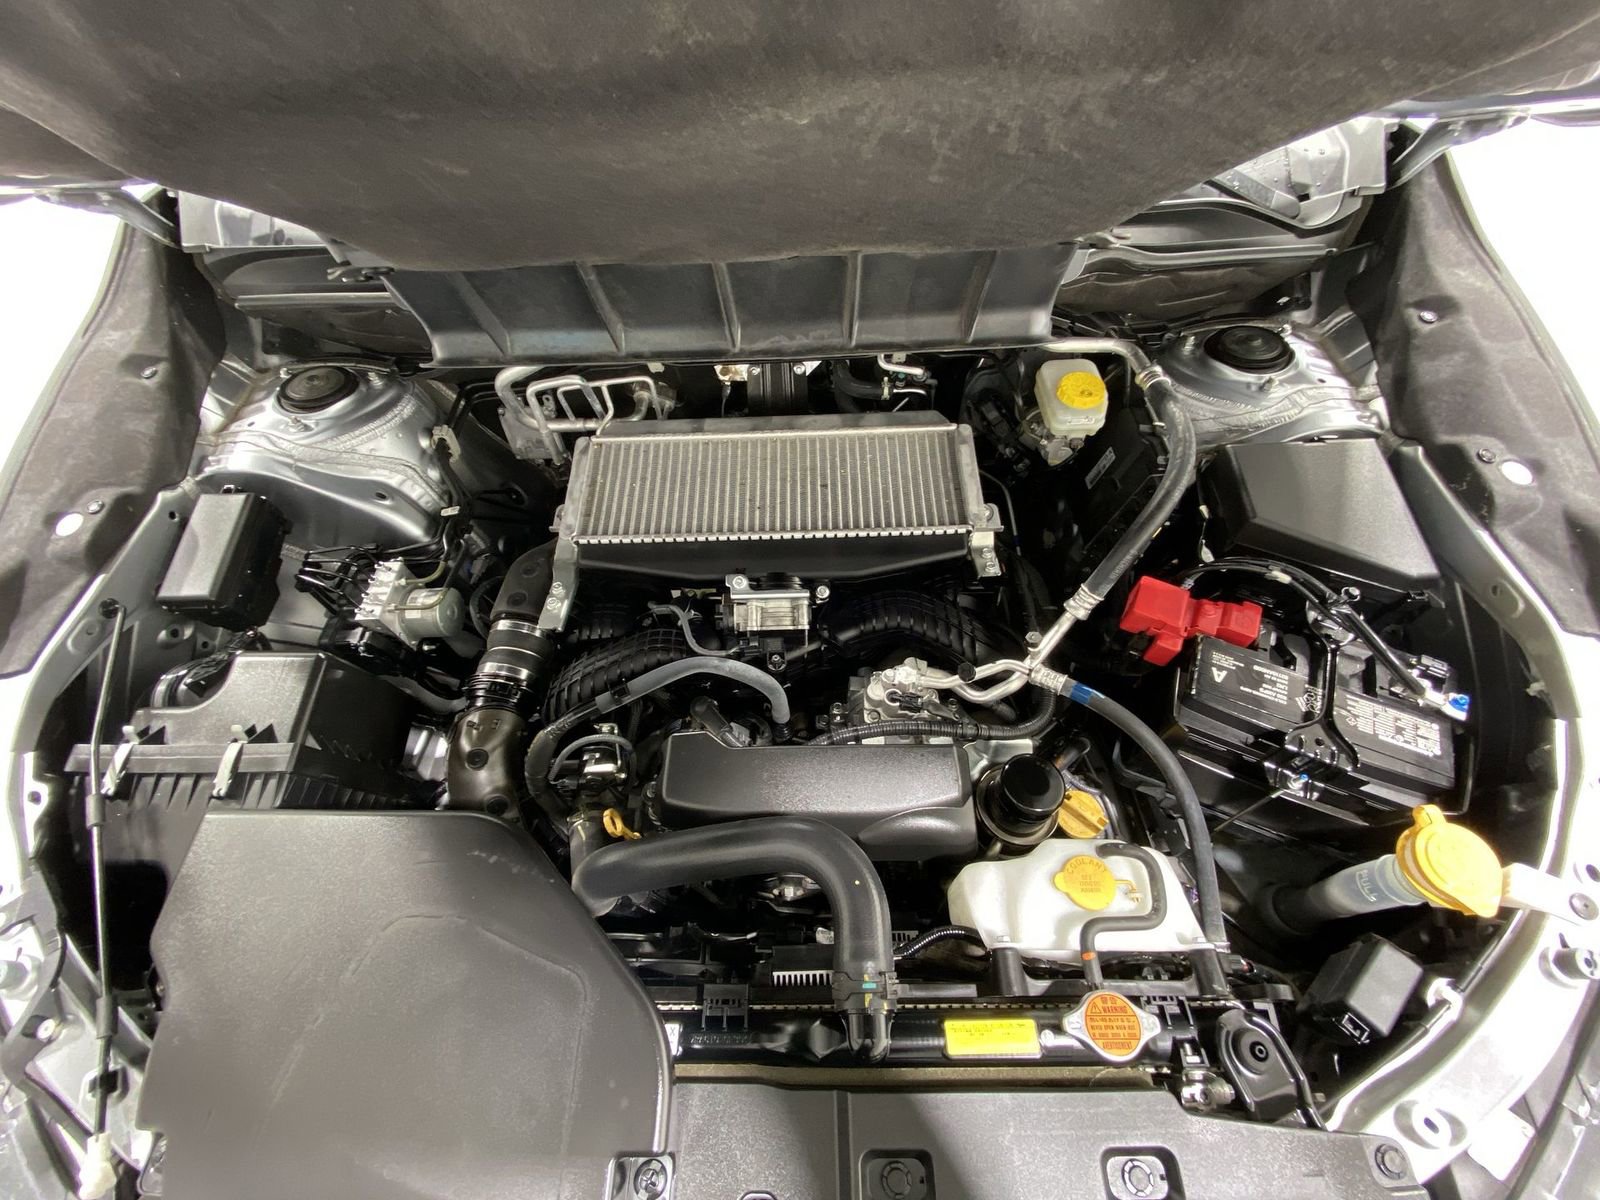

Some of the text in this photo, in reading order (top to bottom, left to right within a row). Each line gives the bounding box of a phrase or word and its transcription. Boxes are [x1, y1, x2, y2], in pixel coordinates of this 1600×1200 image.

[1211, 667, 1228, 682] A
[1066, 857, 1106, 873] COOLANT
[1101, 1005, 1127, 1014] WARNING
